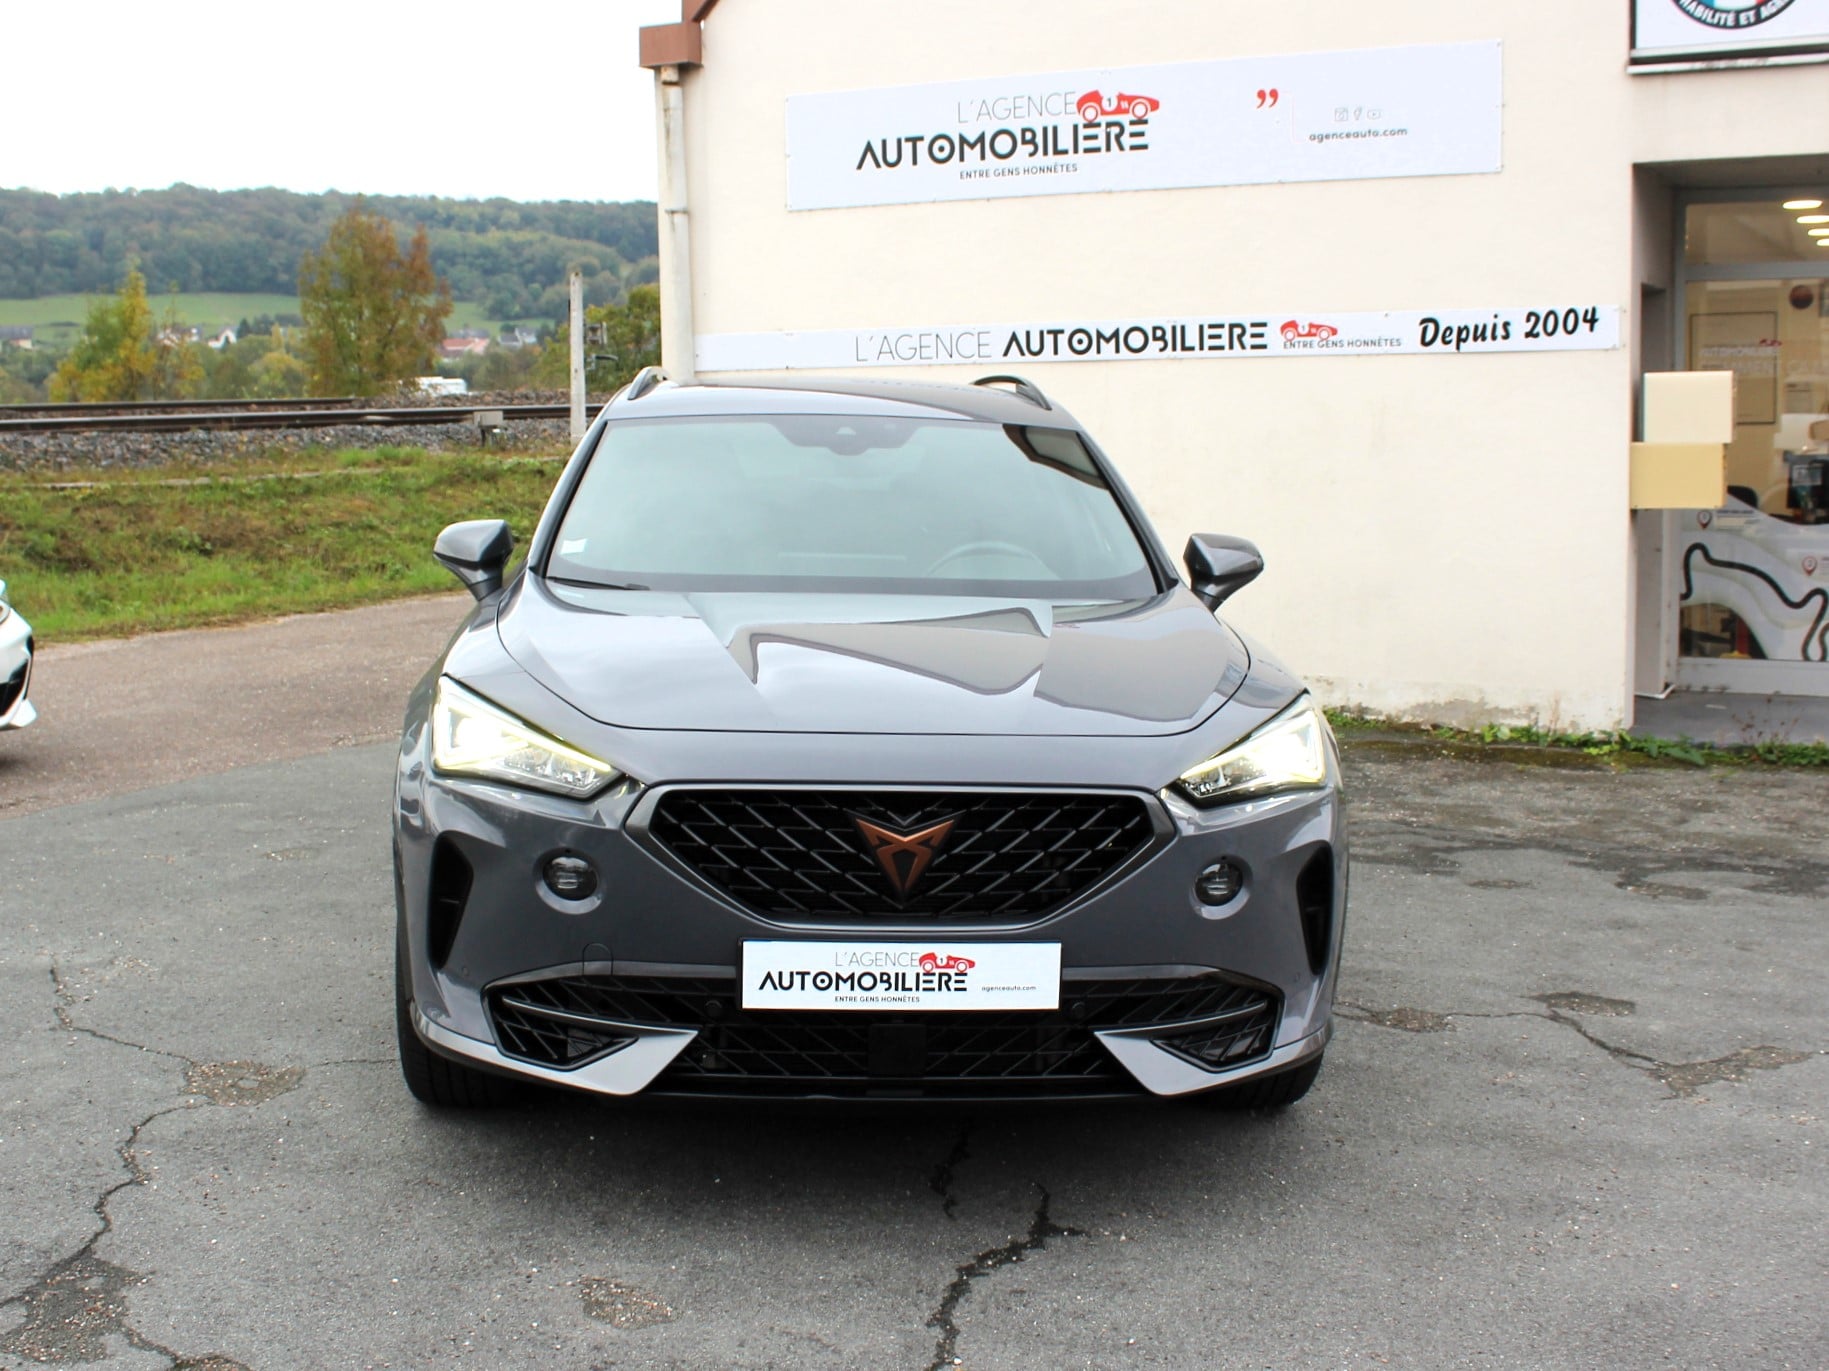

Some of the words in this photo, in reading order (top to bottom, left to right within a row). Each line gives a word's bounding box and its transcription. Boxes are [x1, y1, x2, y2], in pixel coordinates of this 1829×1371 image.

[1739, 10, 1757, 26] ET
[957, 91, 1077, 124] L'AGENCE
[1309, 127, 1408, 143] agenceauto.com
[960, 168, 991, 180] ENTRE
[993, 167, 1021, 178] GENS
[1023, 162, 1078, 176] HONNÊTES
[1419, 313, 1512, 352] Depuis
[1524, 306, 1599, 339] 2004
[855, 331, 992, 362] L'AGENCE
[1283, 340, 1315, 350] ENTRE
[1317, 339, 1345, 349] GENS
[1347, 336, 1402, 348] HONNÊTES
[835, 951, 920, 968] L'AGENCE
[981, 984, 1037, 992] agenceauto.com
[834, 995, 858, 1003] ENTRE
[860, 995, 880, 1003] GENS
[881, 994, 921, 1003] HONNÊTES
